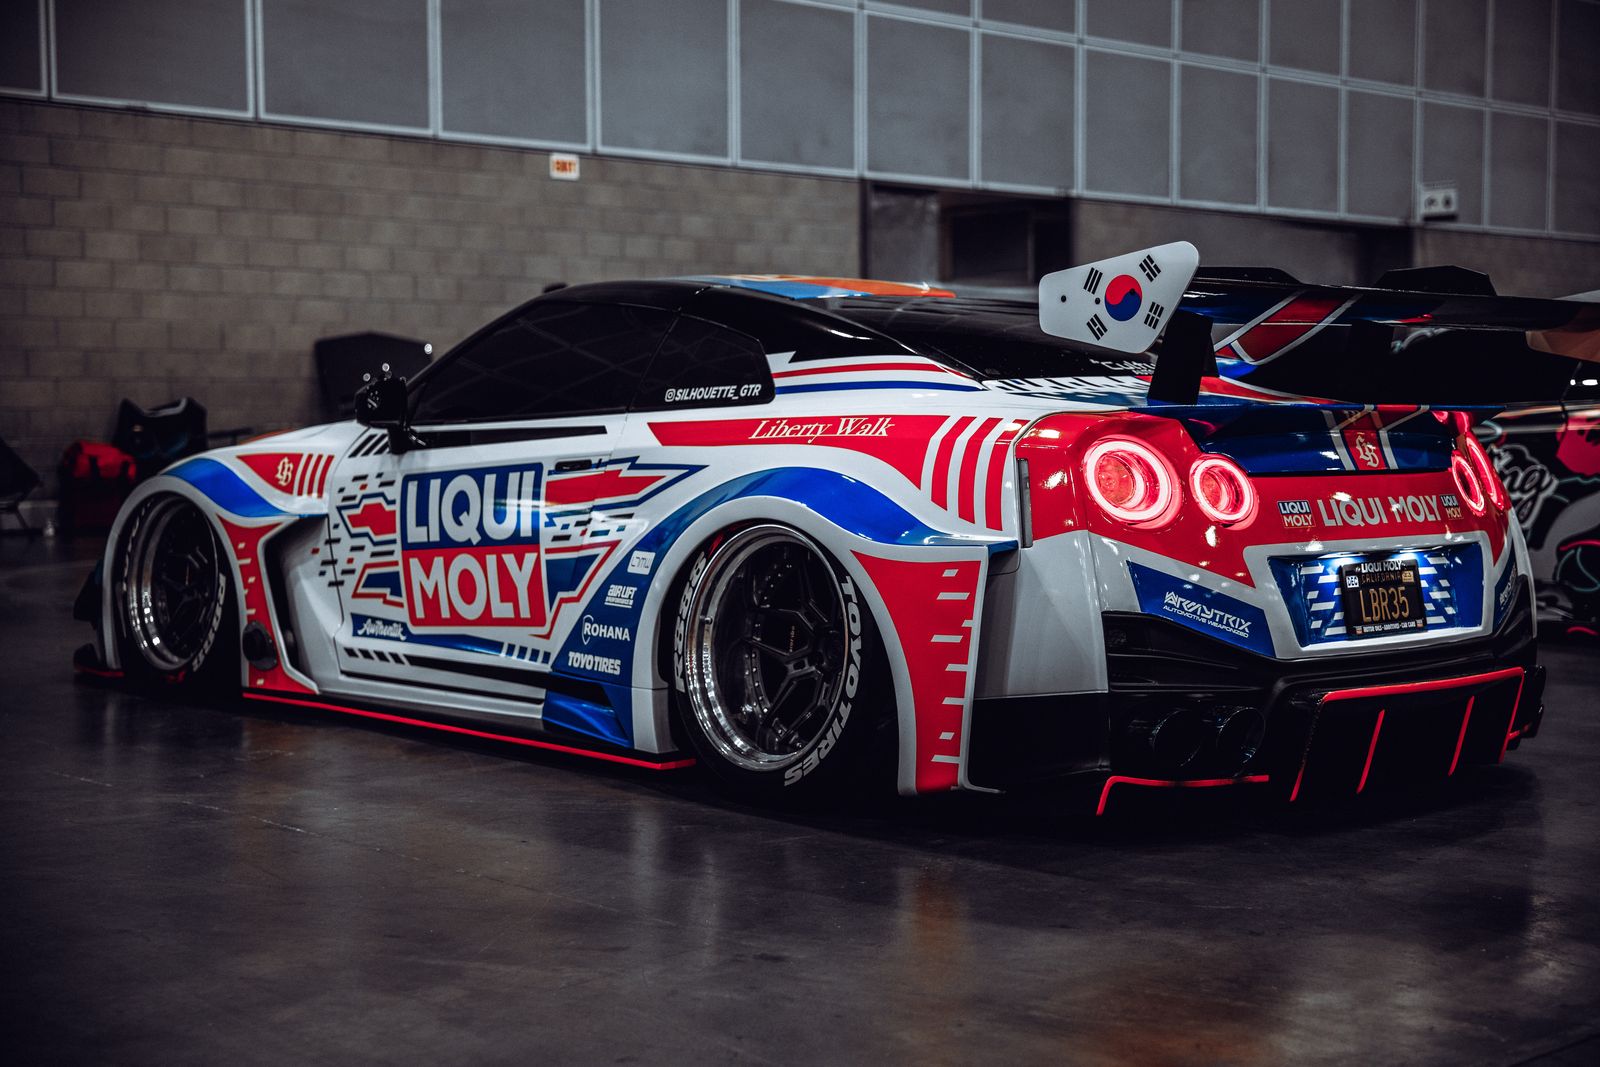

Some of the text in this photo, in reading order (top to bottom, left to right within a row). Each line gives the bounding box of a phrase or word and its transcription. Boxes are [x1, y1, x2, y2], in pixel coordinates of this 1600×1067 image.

[748, 417, 895, 443] Liberty Walk
[406, 470, 536, 545] LIQUI
[1278, 501, 1311, 514] LIQUI
[1317, 495, 1442, 527] LIQUI MOLY
[1440, 494, 1458, 507] LIQUI
[1283, 514, 1313, 527] MOLY
[1446, 507, 1462, 519] MOLY
[1361, 560, 1402, 573] LIQUI MOLY
[1361, 571, 1401, 584] CALIFORNIA
[409, 553, 538, 620] MOLY
[1360, 587, 1410, 623] LBR35
[583, 622, 631, 641] ROHANA
[1163, 605, 1249, 638] AUTOMOTIVE WEAPONIZED
[783, 575, 862, 787] TOYO TIRES
